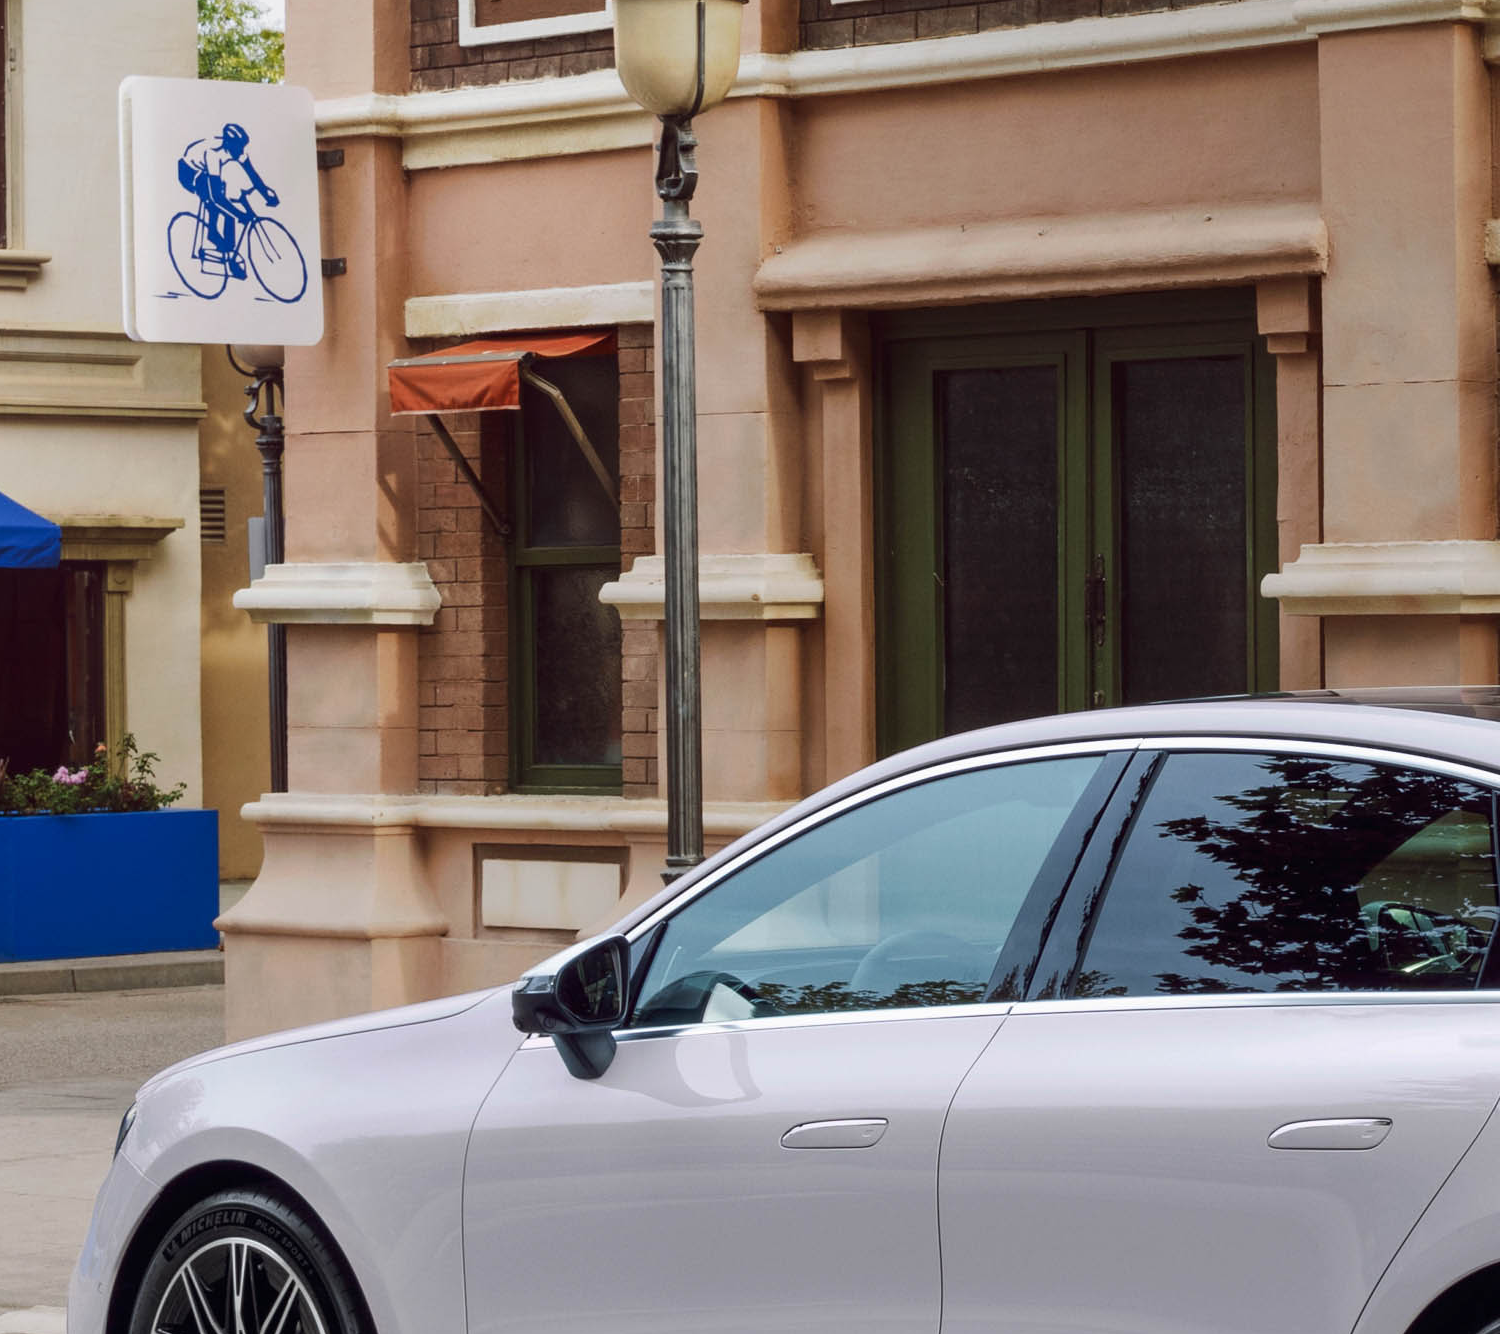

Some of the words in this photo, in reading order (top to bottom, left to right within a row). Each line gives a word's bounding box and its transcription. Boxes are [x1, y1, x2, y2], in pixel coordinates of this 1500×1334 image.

[180, 1211, 248, 1243] MICHELIN
[255, 1218, 281, 1237] PILOT
[281, 1237, 309, 1266] SPORT
